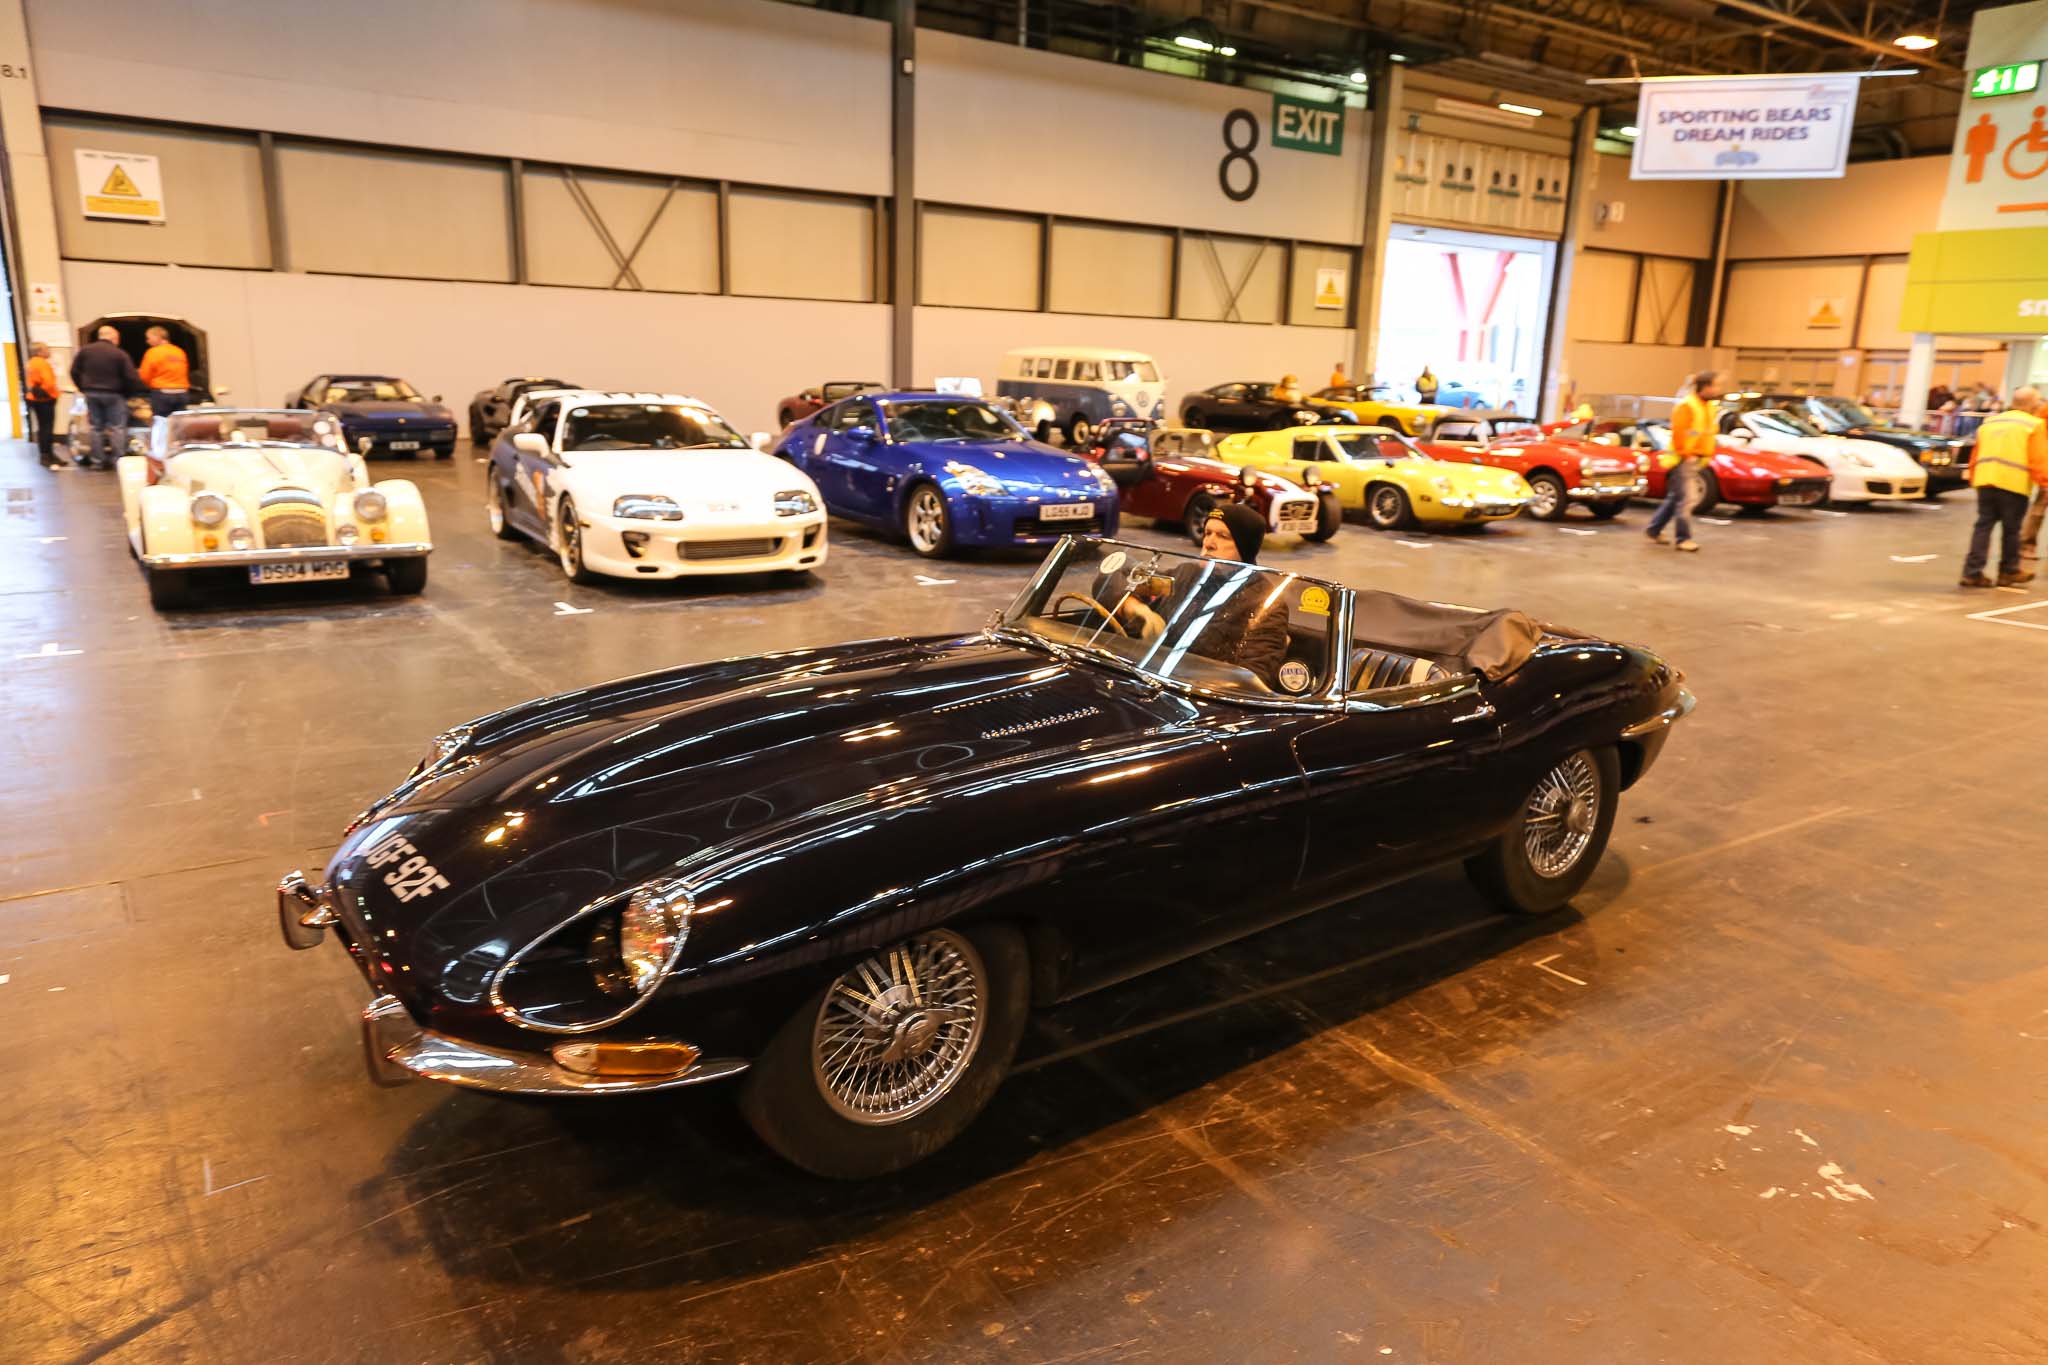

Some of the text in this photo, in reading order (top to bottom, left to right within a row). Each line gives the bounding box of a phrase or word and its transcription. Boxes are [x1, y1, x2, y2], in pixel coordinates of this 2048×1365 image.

[1278, 103, 1340, 146] EXIT
[1658, 106, 1832, 124] SPORTING BEARS
[1673, 126, 1809, 142] DREAM RIDES
[1219, 108, 1259, 202] 8
[384, 856, 451, 903] 92F
